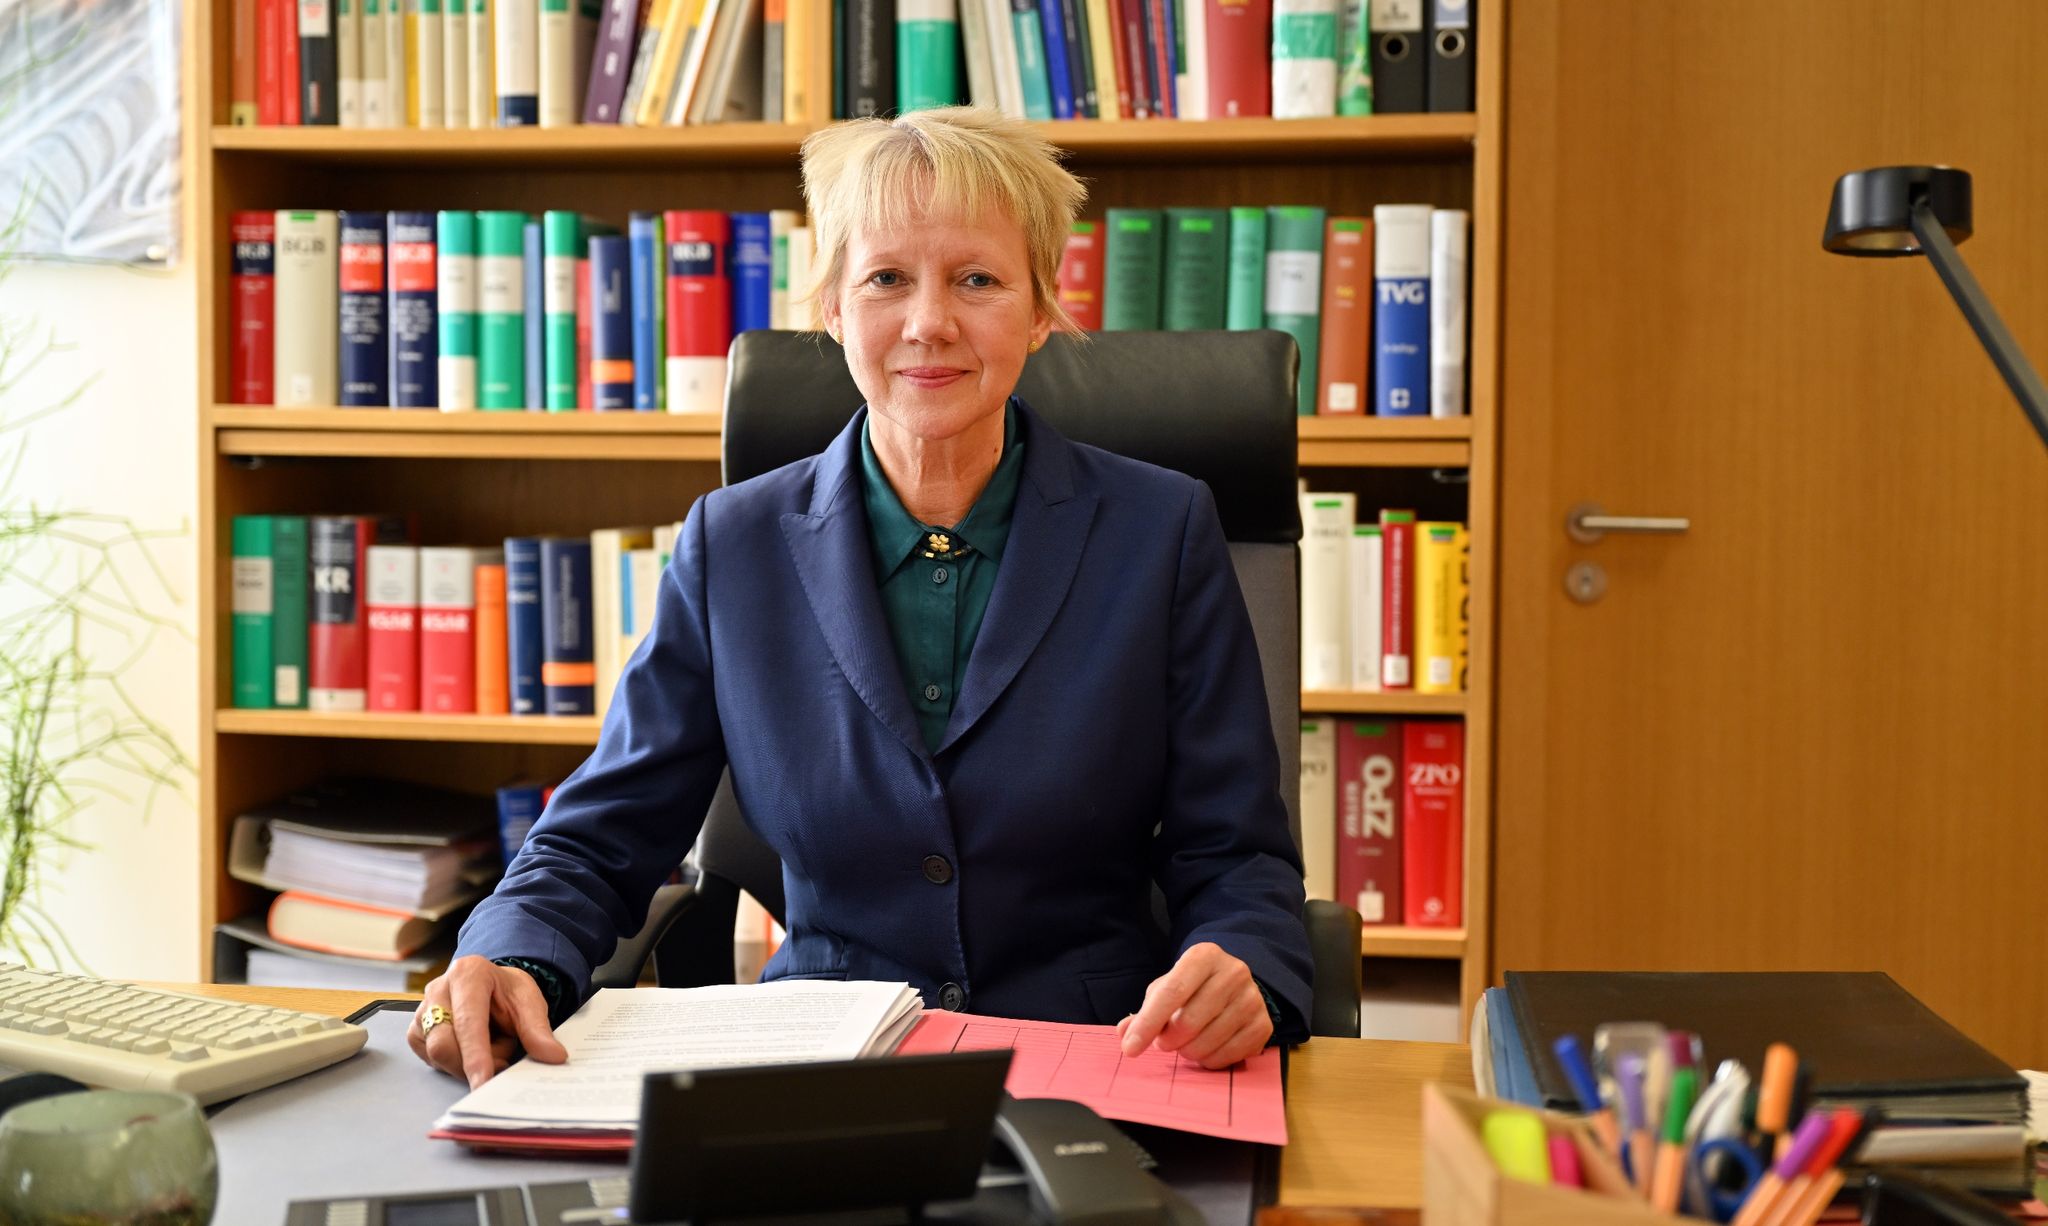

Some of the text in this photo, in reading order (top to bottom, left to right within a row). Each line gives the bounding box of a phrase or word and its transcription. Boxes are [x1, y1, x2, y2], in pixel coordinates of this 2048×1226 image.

[236, 242, 271, 260] BGB
[282, 238, 326, 255] BGB
[341, 245, 383, 264] BGB
[393, 245, 434, 264] BGB
[1378, 282, 1425, 304] TVG
[314, 566, 351, 593] KR
[1409, 763, 1460, 786] ZPO
[1363, 756, 1394, 839] ZPO
